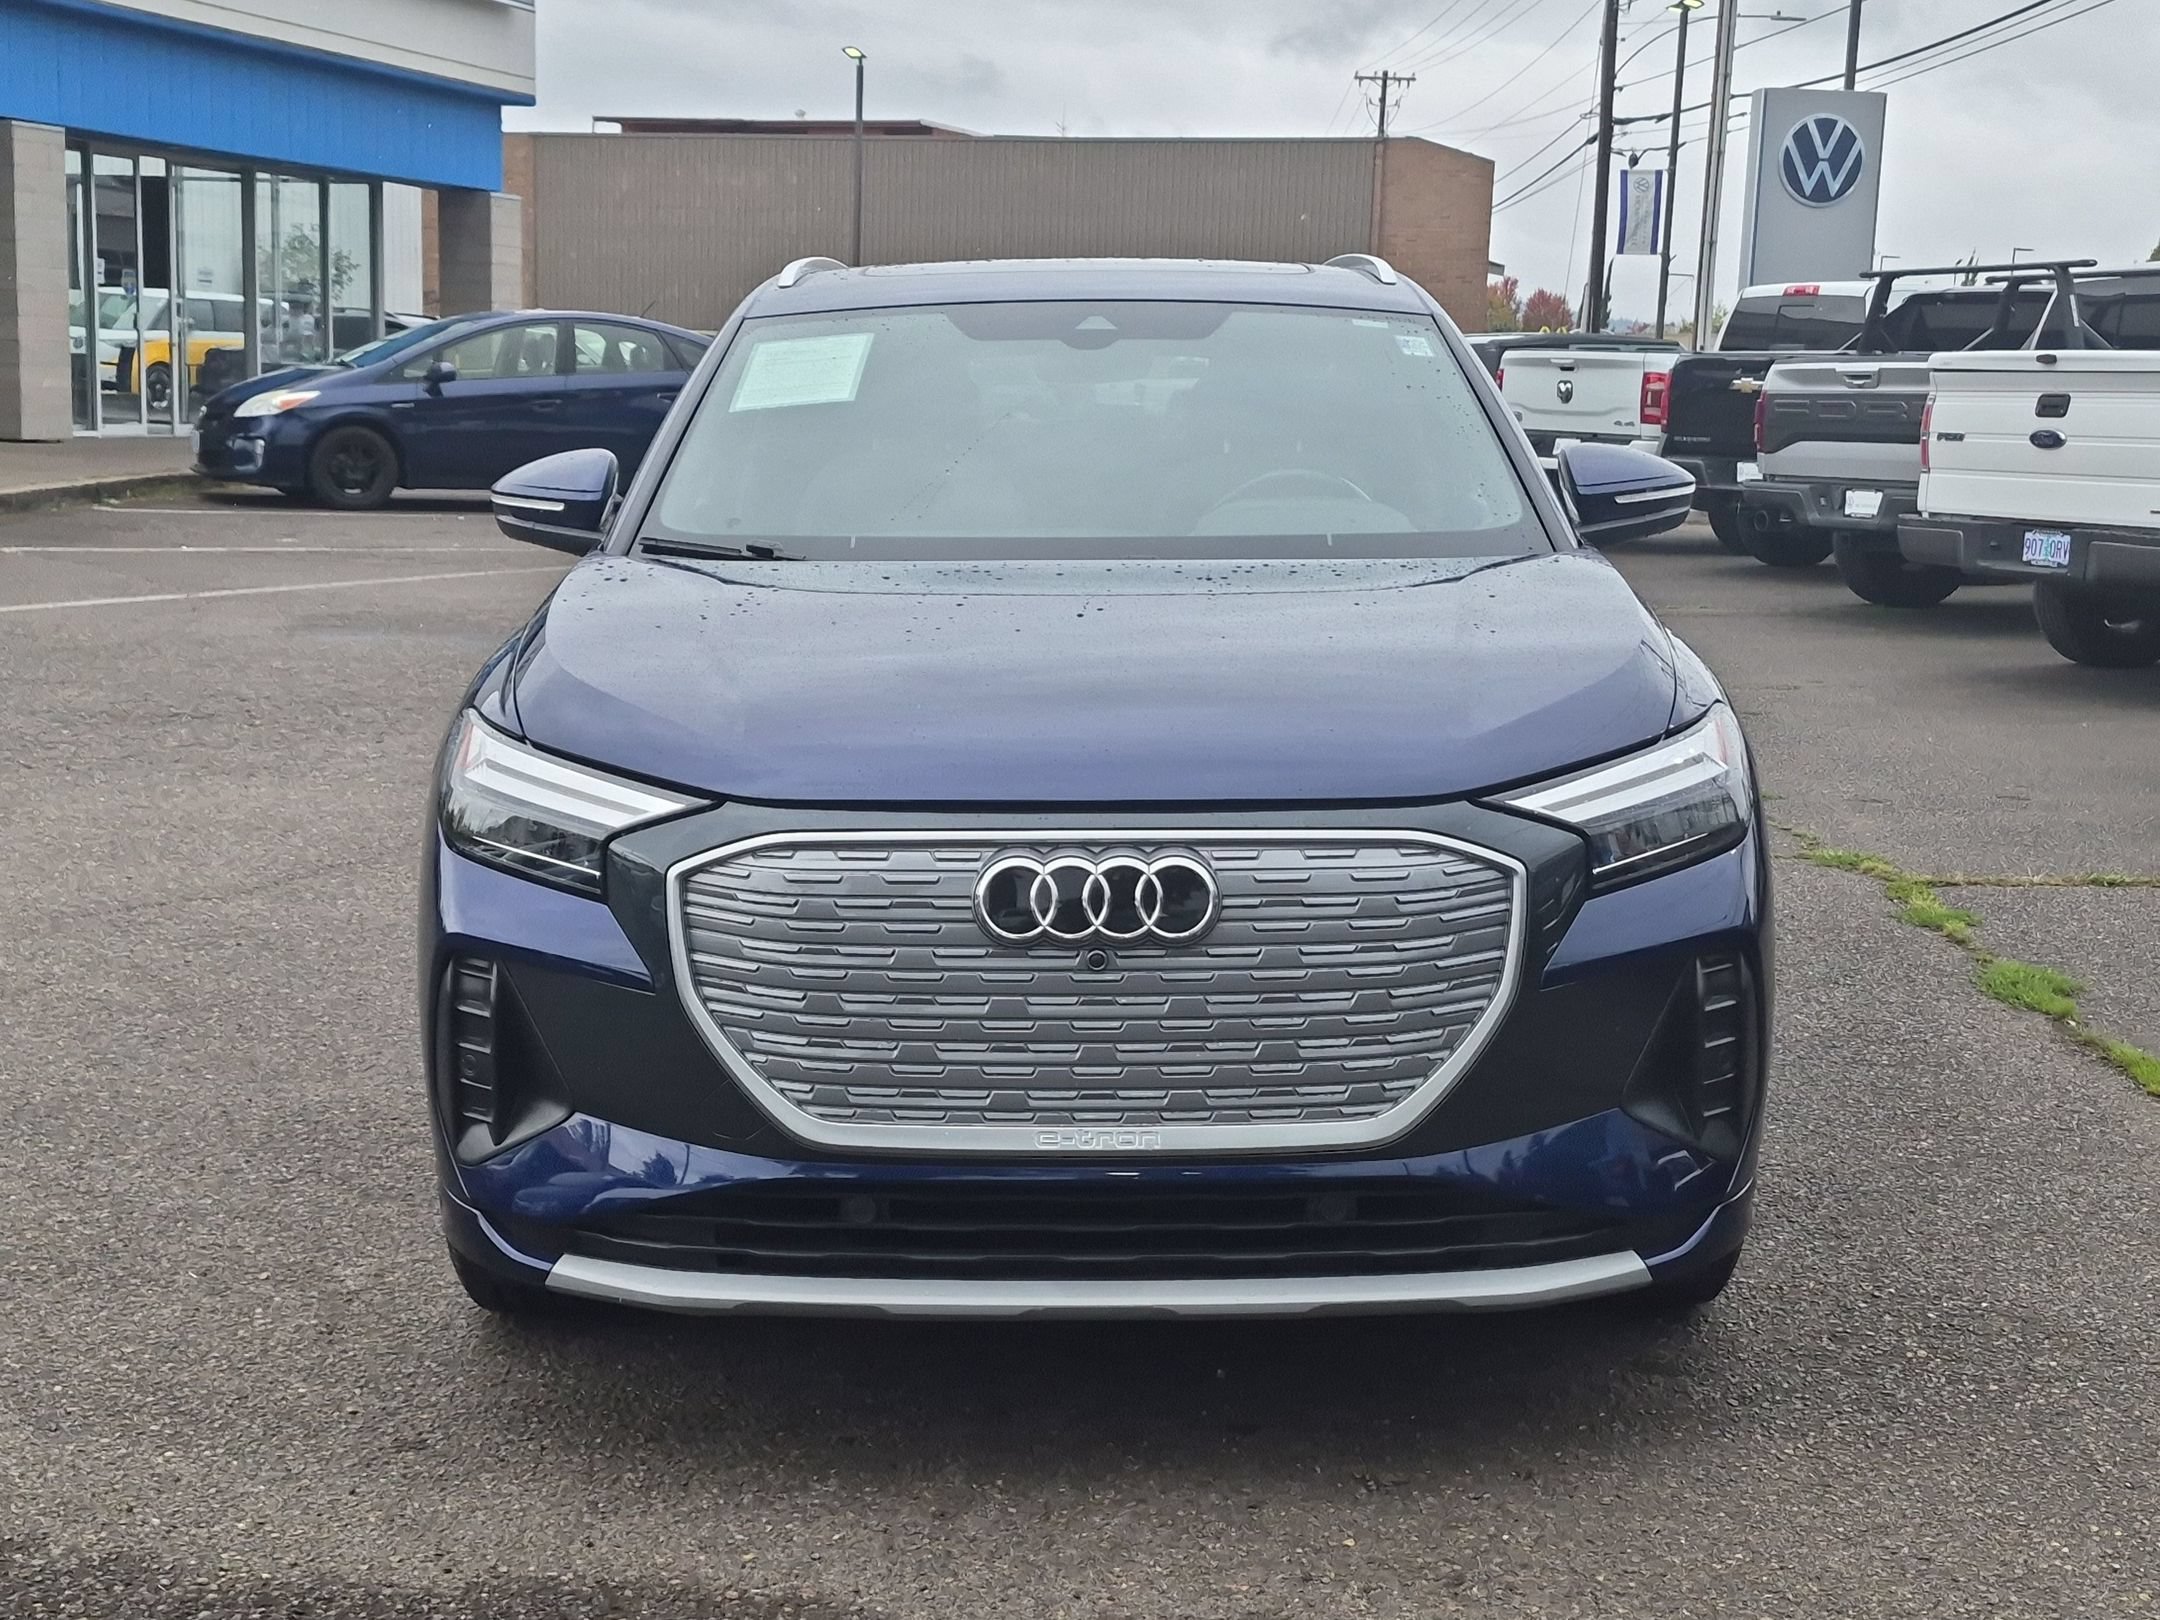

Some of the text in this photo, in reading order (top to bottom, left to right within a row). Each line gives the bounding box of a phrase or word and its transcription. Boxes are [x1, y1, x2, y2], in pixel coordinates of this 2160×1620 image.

[1773, 399, 1922, 420] FOR
[2025, 537, 2070, 560] 907 ORV
[1035, 1129, 1161, 1149] e-tron
